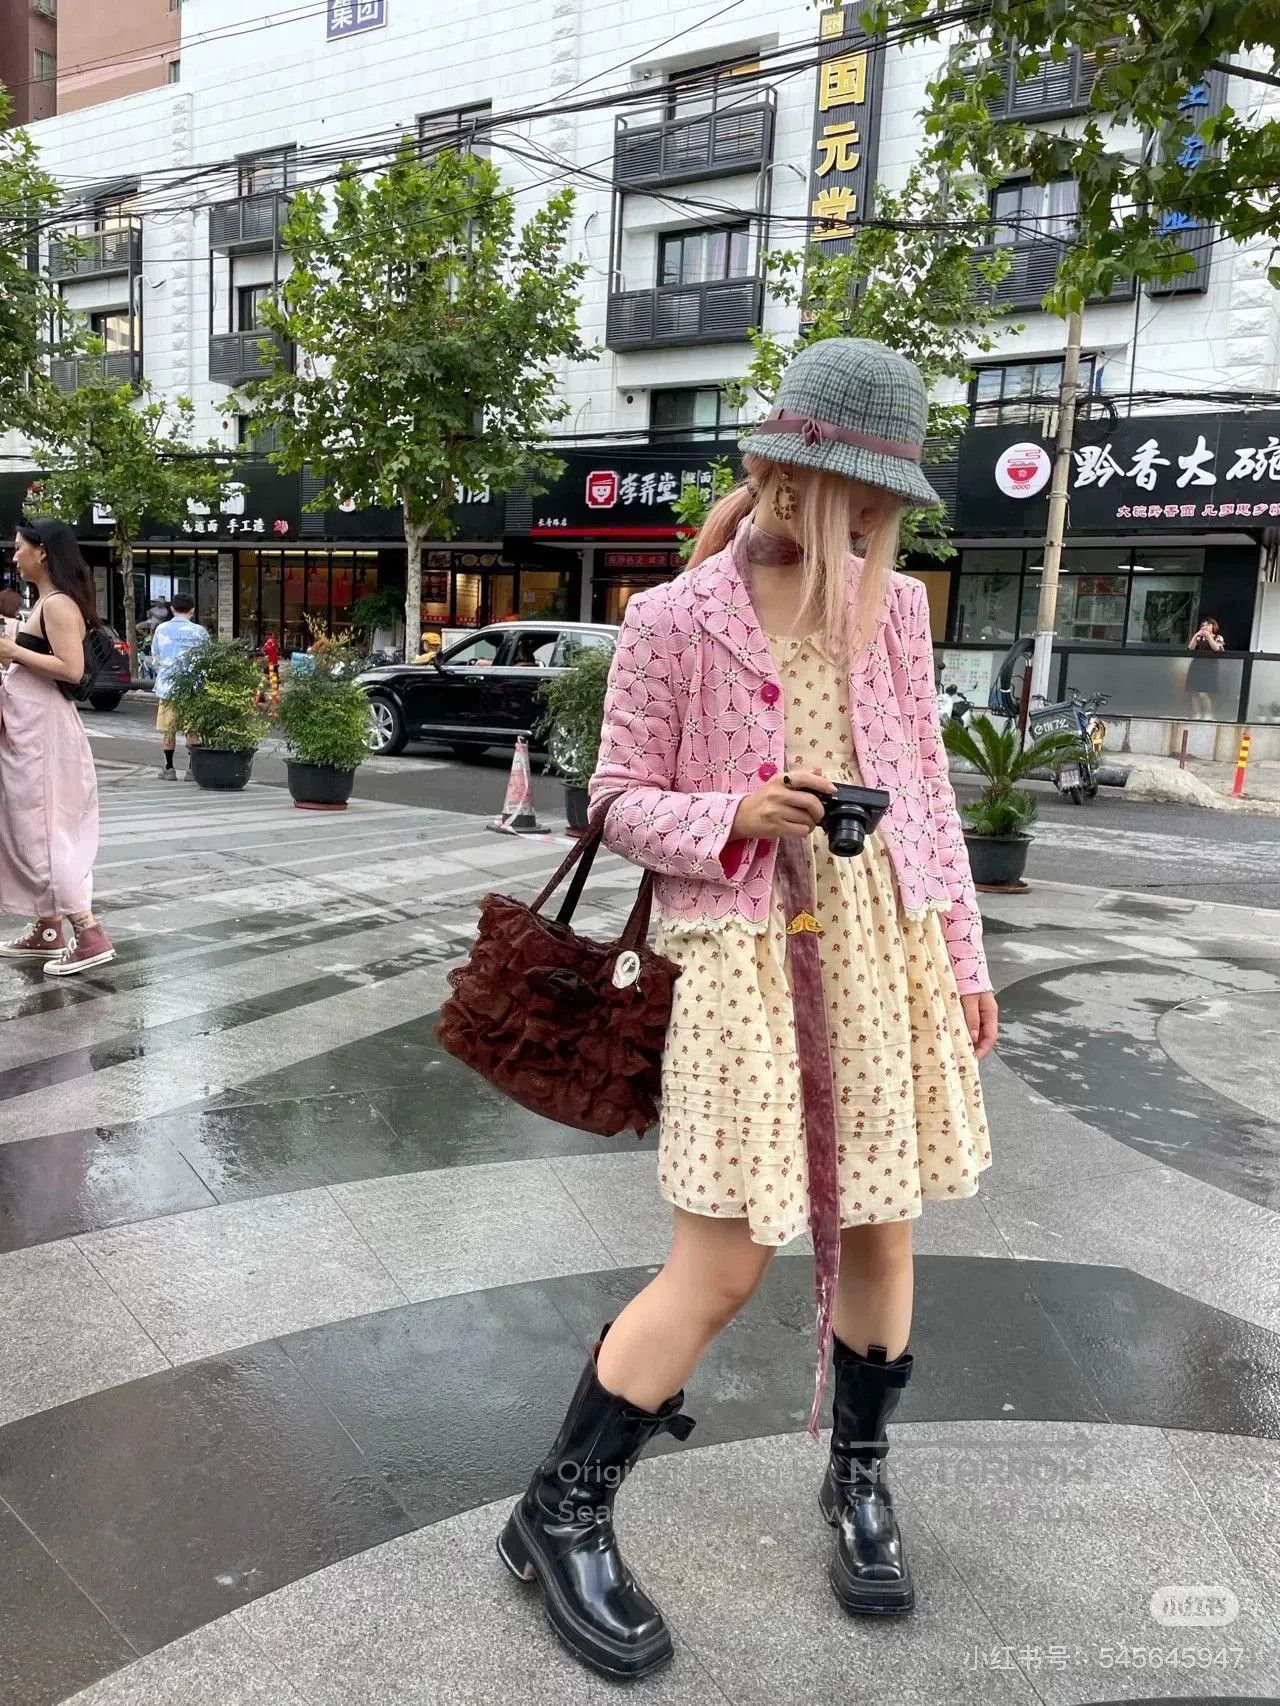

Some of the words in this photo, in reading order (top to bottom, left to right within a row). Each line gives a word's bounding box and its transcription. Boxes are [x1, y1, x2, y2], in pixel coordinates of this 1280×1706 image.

[330, 0, 379, 31] 集团
[809, 49, 867, 242] 国元堂
[1072, 435, 1280, 491] 黔香大碗
[226, 517, 266, 534] 手工造
